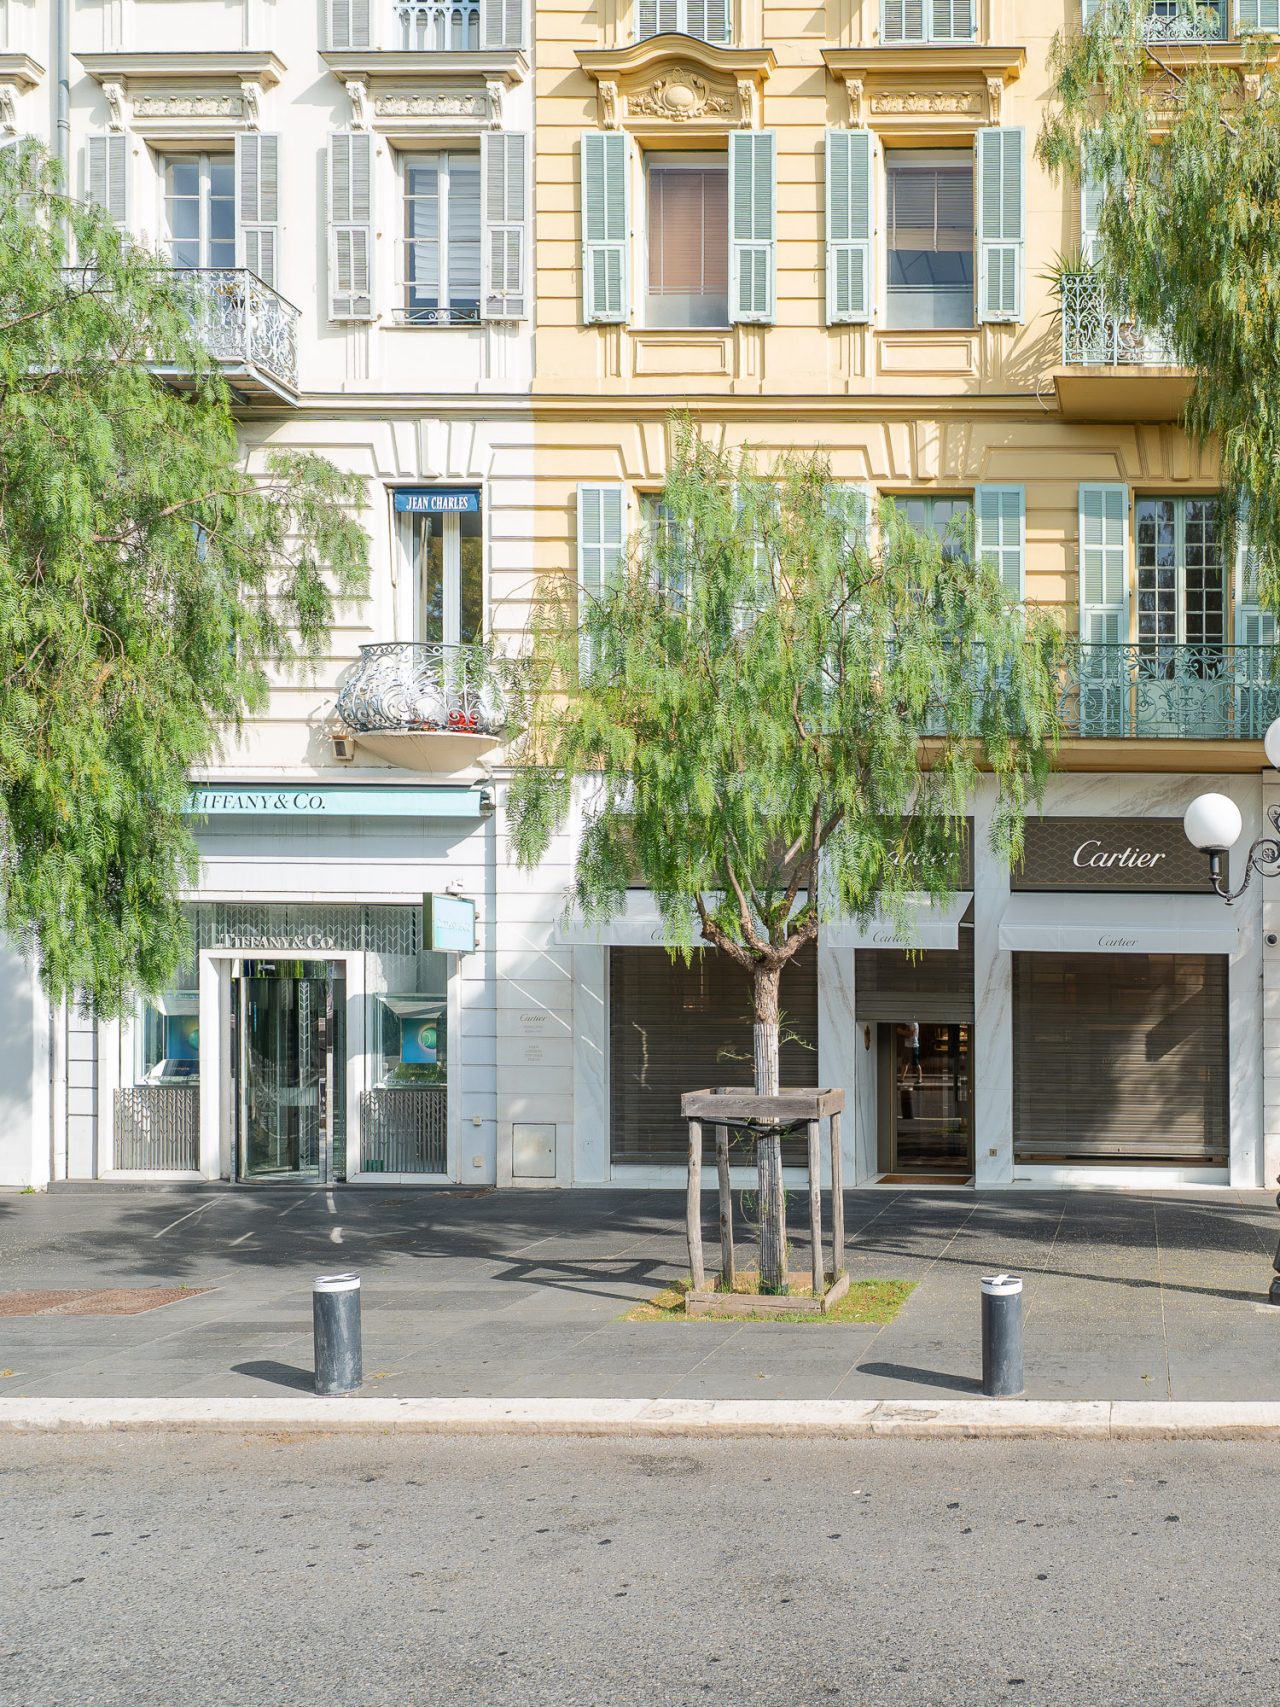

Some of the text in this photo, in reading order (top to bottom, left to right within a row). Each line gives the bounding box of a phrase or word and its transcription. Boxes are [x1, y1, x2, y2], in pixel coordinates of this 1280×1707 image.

[406, 496, 469, 510] JEAN CHARLES
[1072, 839, 1166, 868] Cartier
[1098, 934, 1138, 947] Cartier
